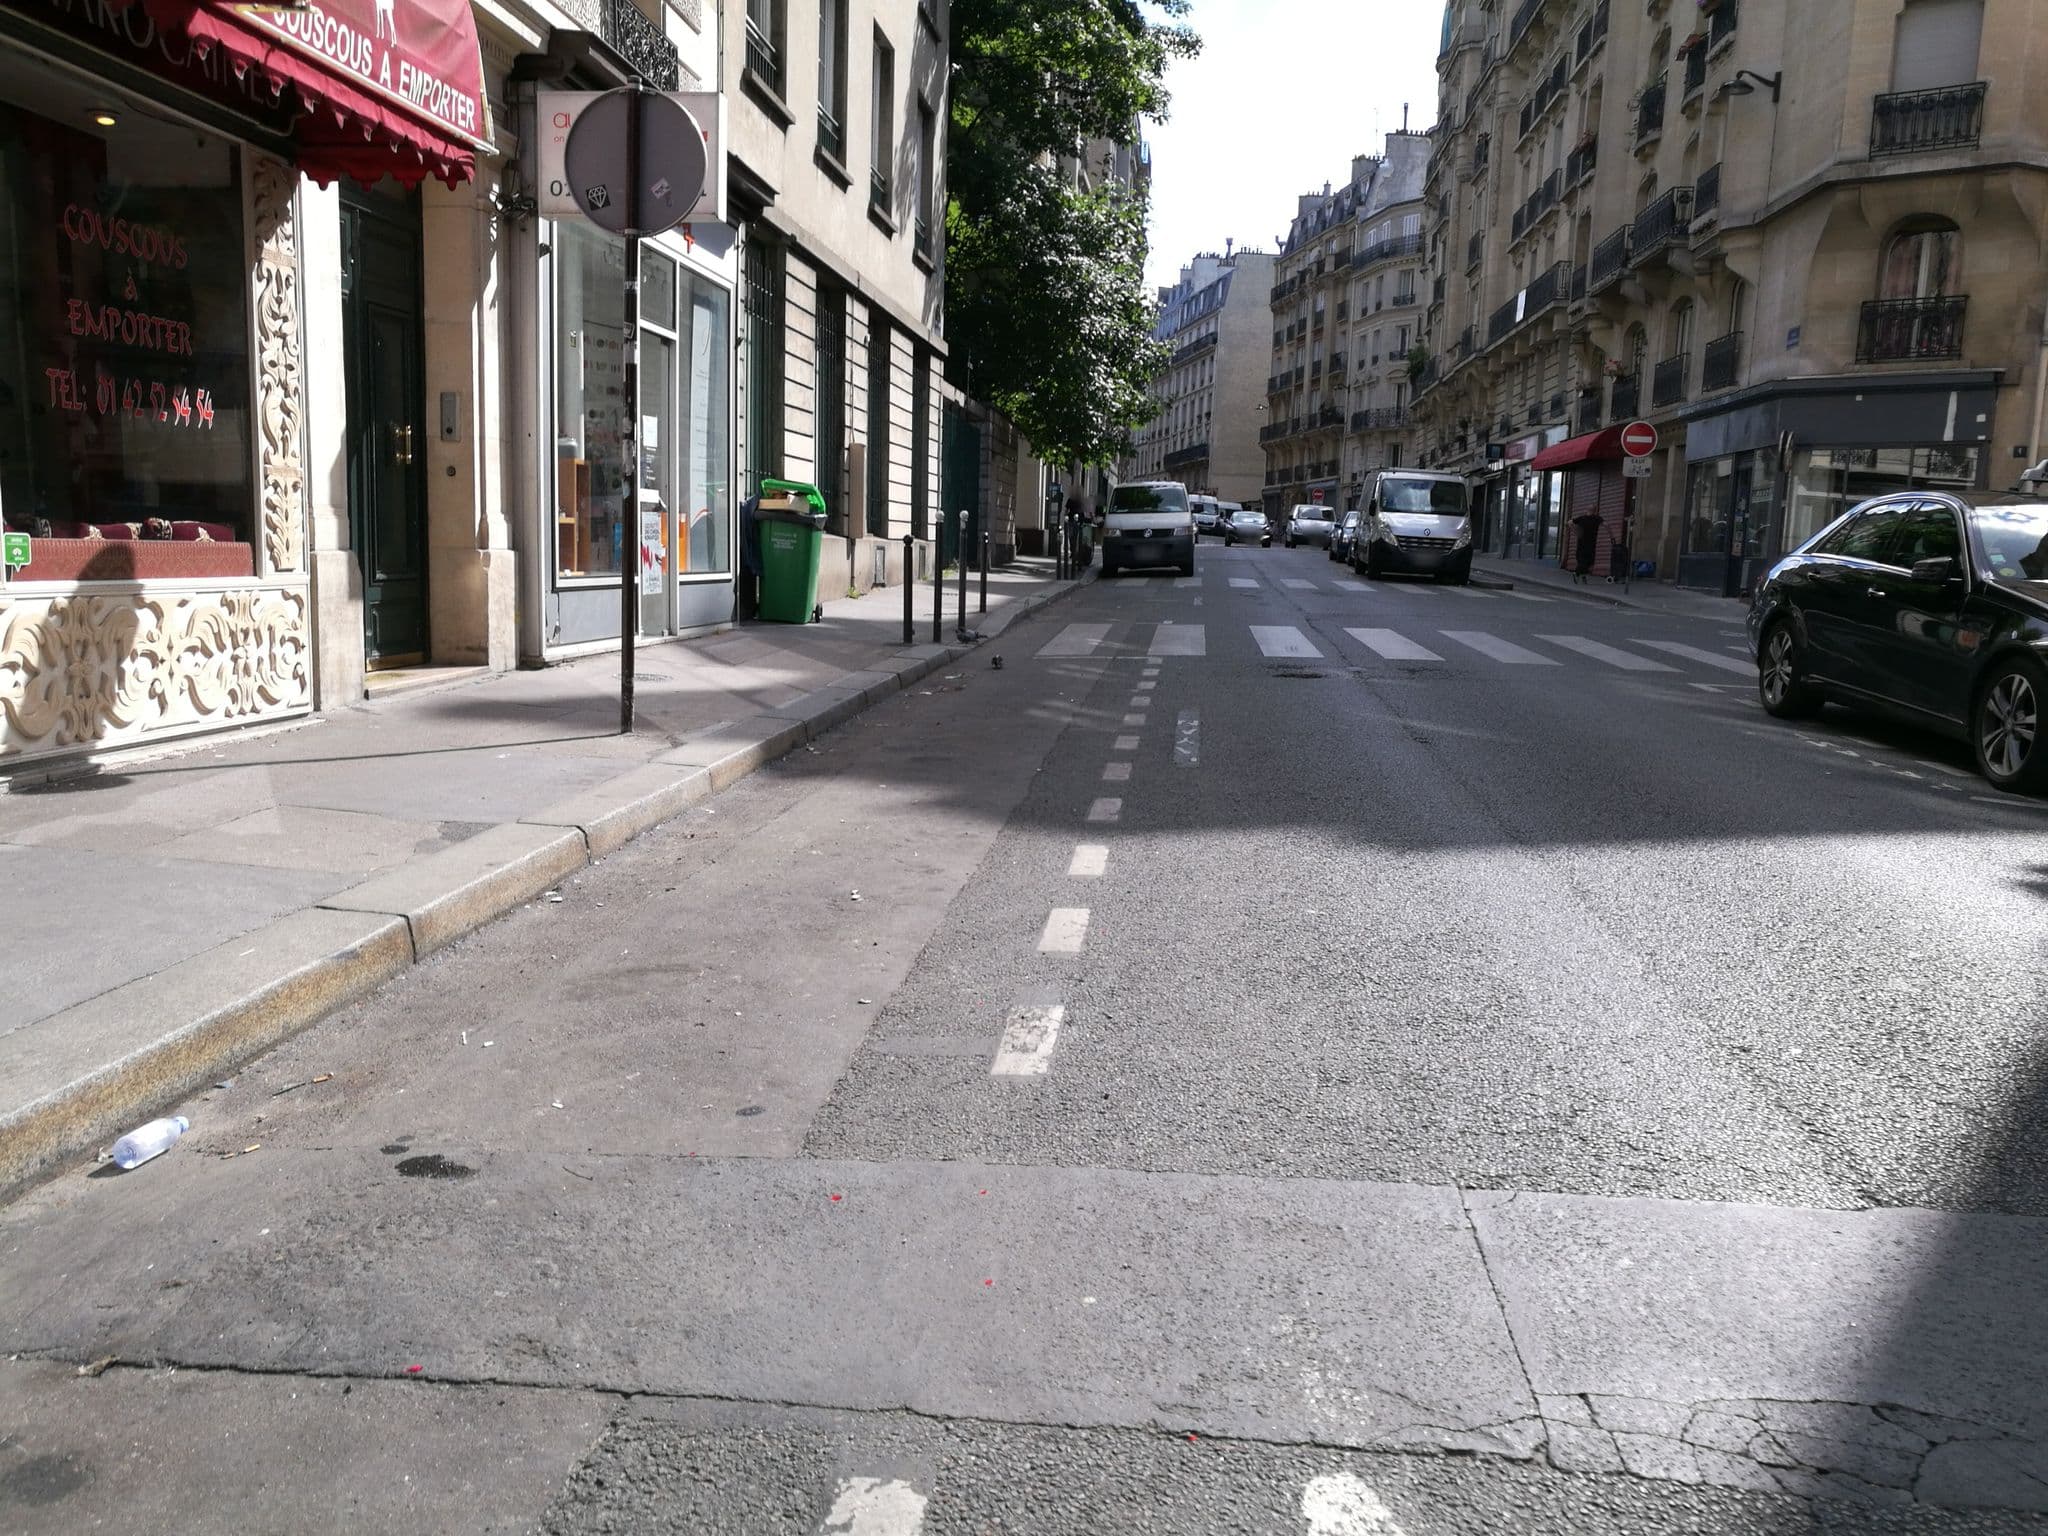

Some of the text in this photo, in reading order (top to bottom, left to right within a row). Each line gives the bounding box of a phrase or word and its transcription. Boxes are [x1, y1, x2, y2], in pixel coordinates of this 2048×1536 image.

[53, 0, 280, 110] ROCAINE
[380, 50, 392, 90] A
[398, 59, 475, 132] EMPORTER
[64, 204, 188, 269] COUSCOUS
[67, 299, 193, 357] EMPORTER
[45, 367, 88, 411] TEL:
